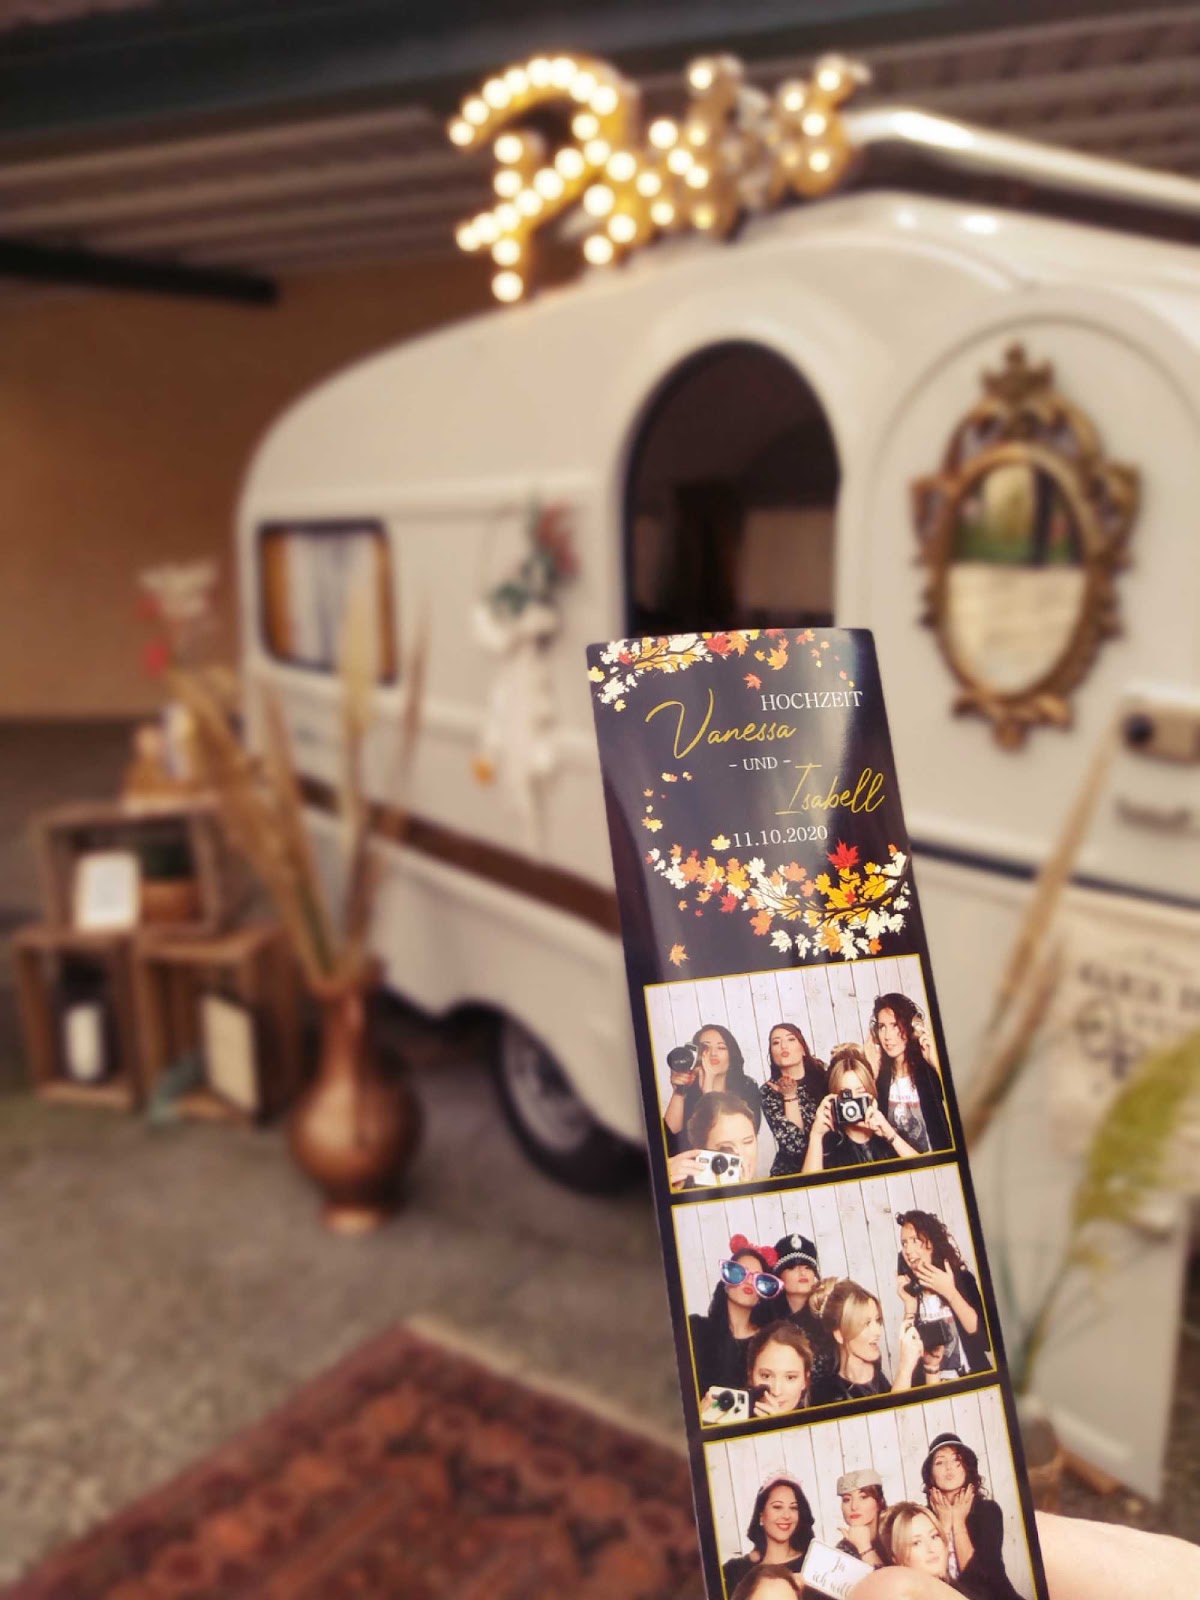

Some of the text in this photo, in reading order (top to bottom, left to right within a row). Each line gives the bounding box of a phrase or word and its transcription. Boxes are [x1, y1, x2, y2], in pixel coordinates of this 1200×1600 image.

[760, 690, 863, 711] HOCHZEIT
[645, 688, 797, 759] Vanessa
[742, 757, 778, 771] UND
[775, 762, 885, 815] Isabell
[733, 825, 829, 848] 11.10.2020
